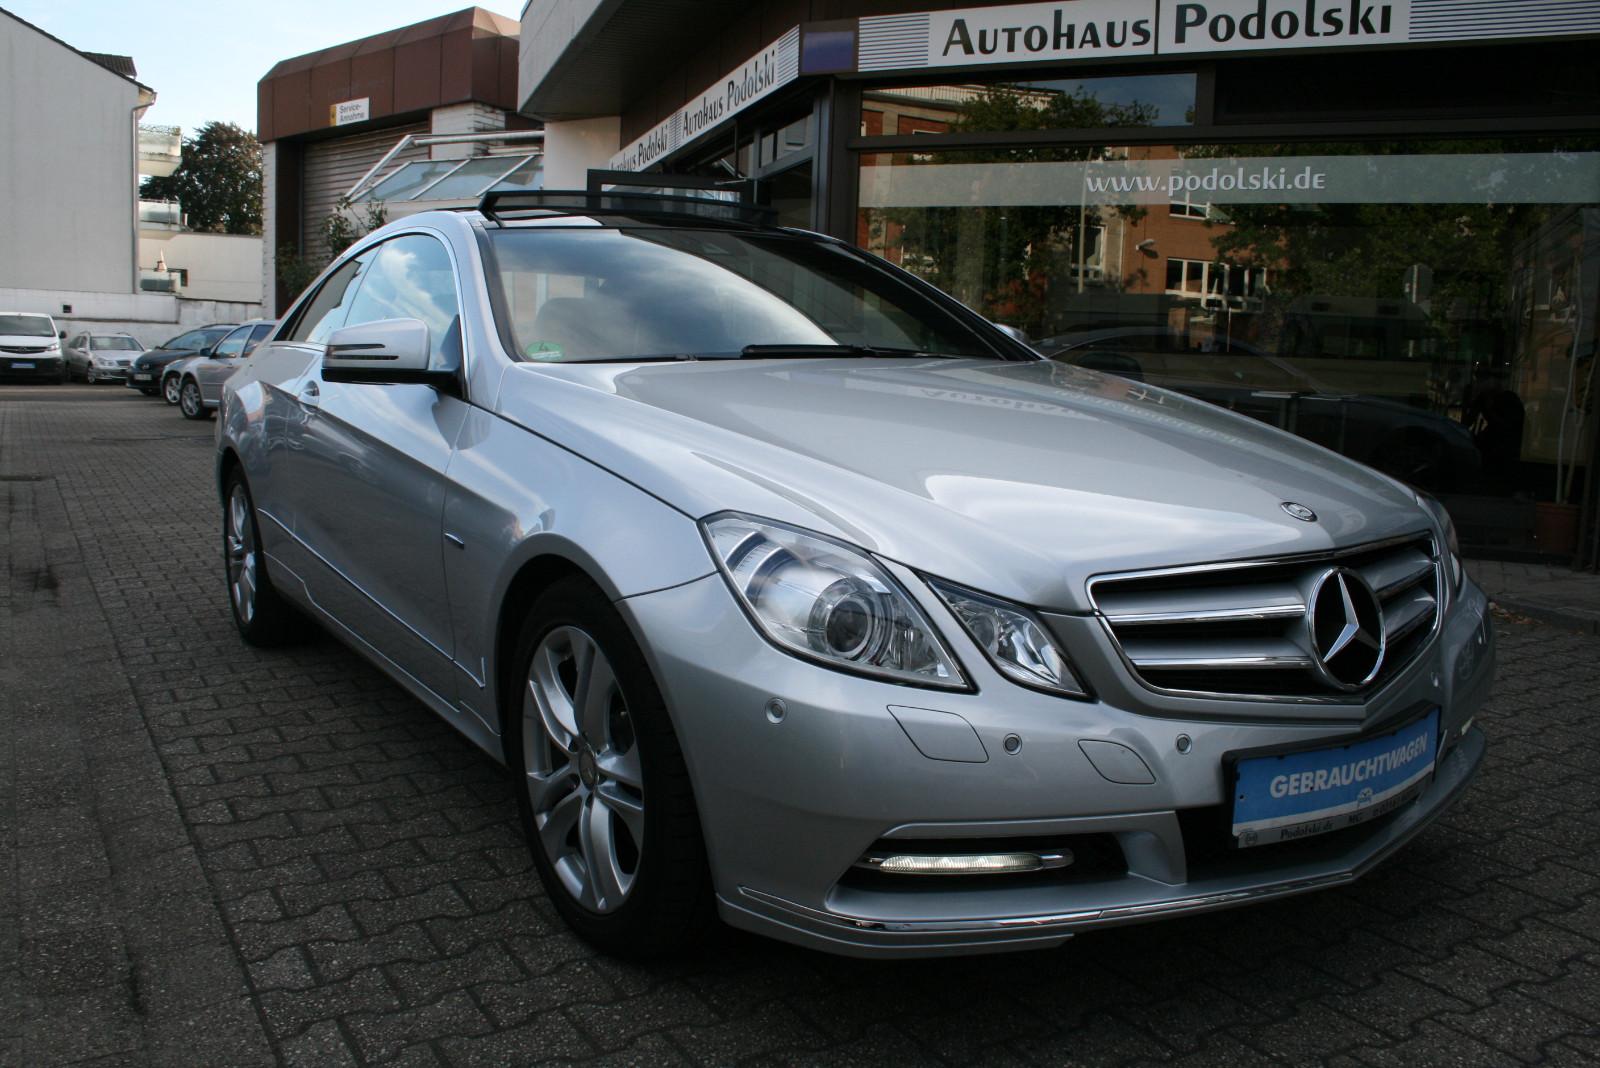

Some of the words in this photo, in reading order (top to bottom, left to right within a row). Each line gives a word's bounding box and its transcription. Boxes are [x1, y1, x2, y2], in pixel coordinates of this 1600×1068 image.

[1174, 0, 1392, 44] Podolski
[727, 50, 775, 112] Podolski
[638, 124, 668, 167] Podolski
[1086, 166, 1326, 197] www.podolski.de
[1270, 733, 1428, 798] GEBRAUCHTWAGEN
